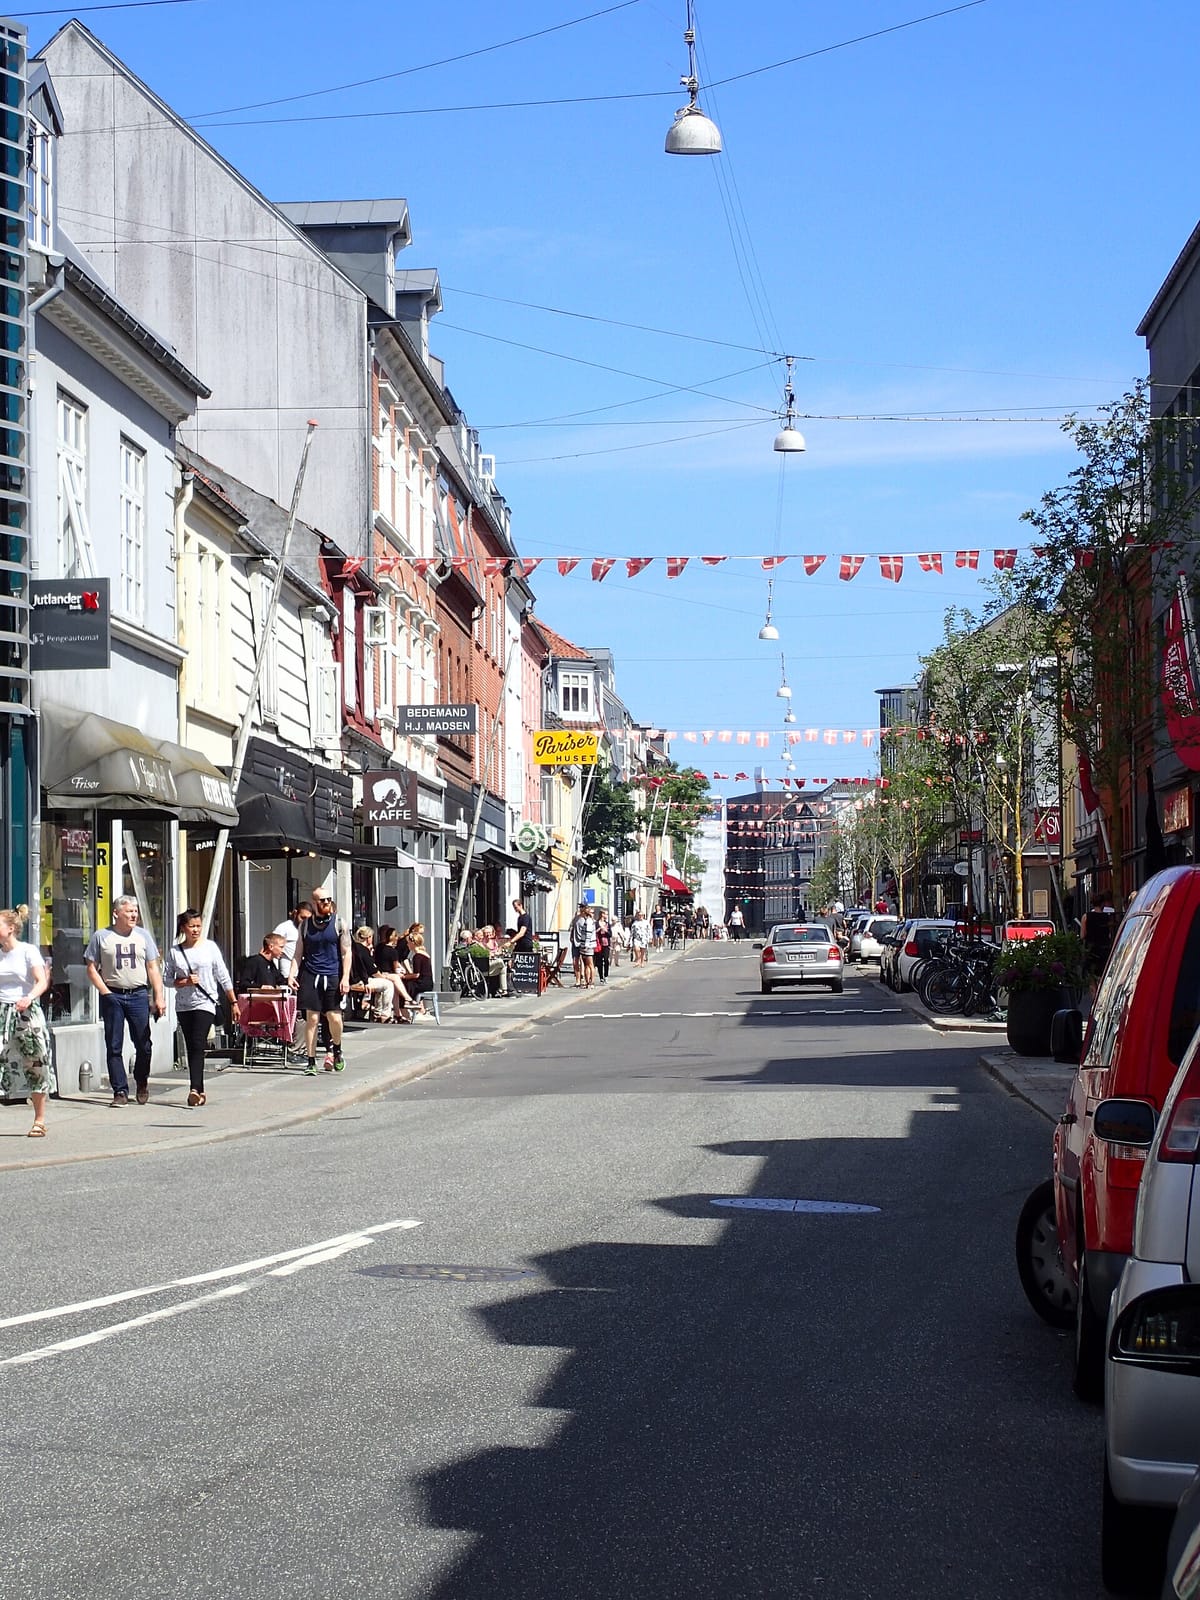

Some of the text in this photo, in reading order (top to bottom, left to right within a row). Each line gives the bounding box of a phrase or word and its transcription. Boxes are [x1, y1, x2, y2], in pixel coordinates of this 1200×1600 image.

[33, 592, 82, 606] Jutlander
[407, 708, 467, 718] BEDEMAND
[405, 721, 470, 731] H.J. MADSEN
[536, 734, 595, 757] Pariser
[369, 809, 411, 821] KAFFE
